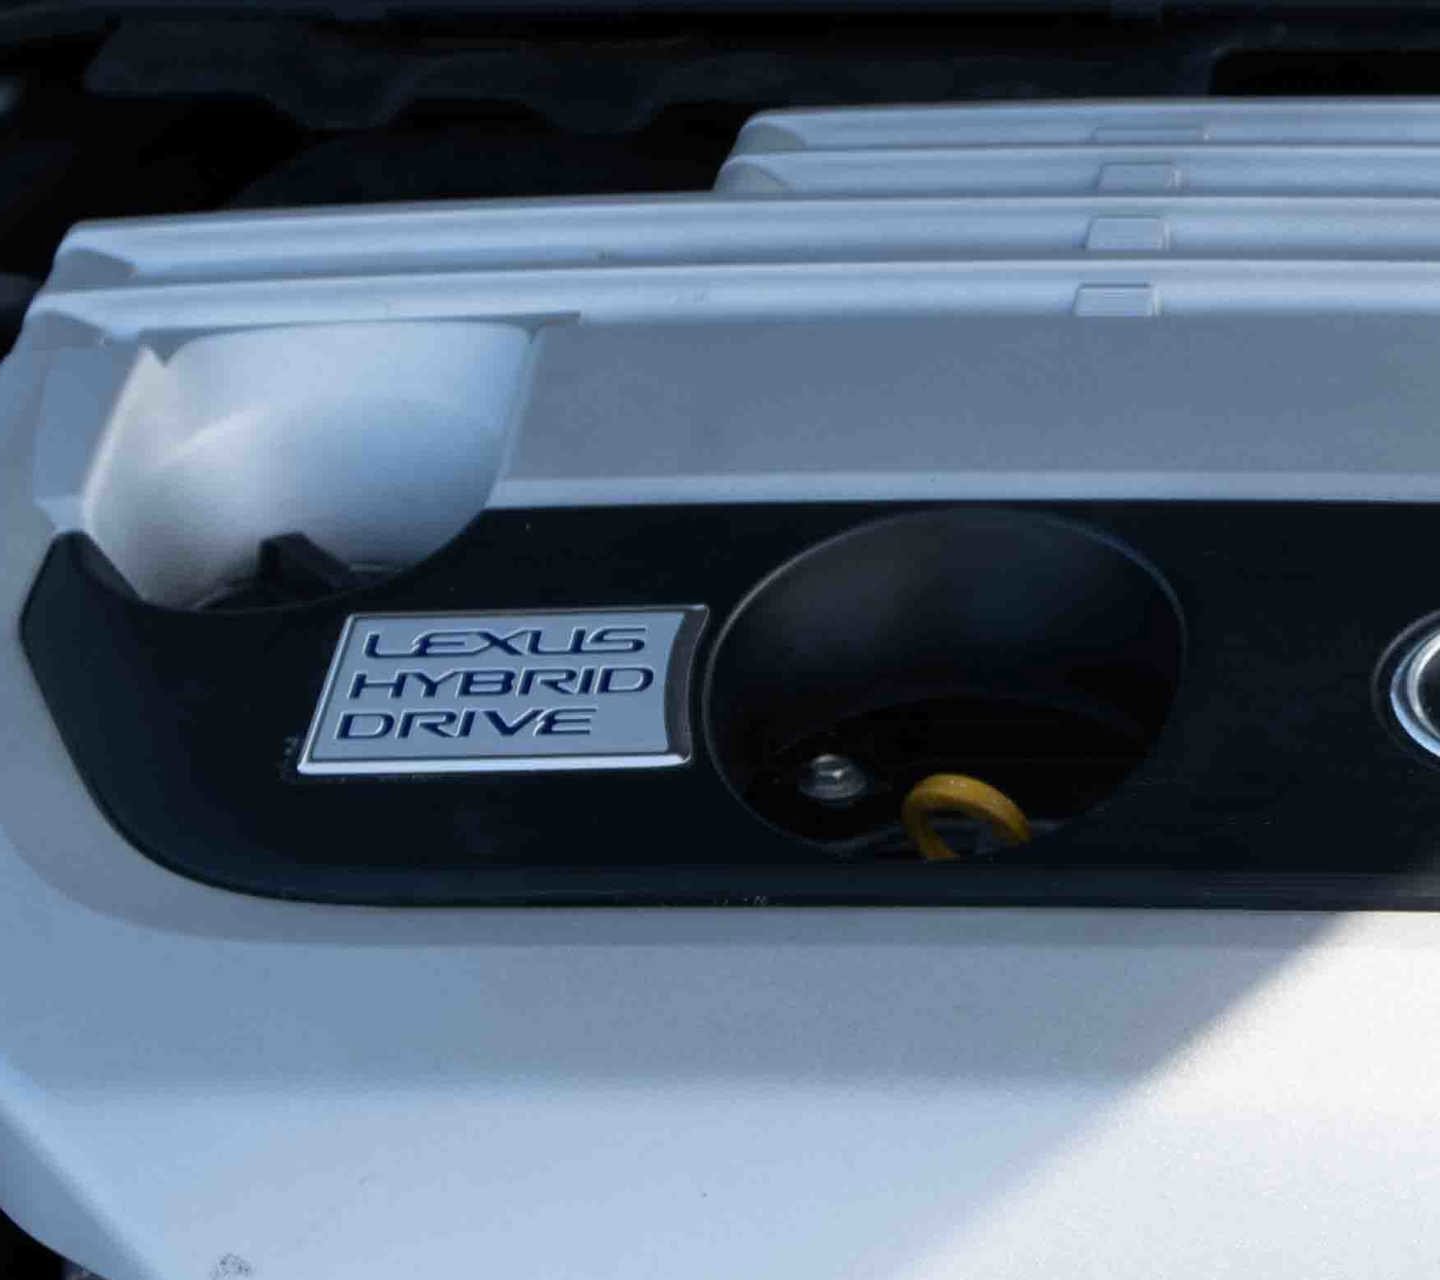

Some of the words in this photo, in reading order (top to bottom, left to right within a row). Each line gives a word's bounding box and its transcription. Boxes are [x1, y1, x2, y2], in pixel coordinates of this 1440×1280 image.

[363, 626, 648, 660] LEXUS
[348, 666, 655, 701] HYBRID
[334, 707, 599, 742] DRIVE
